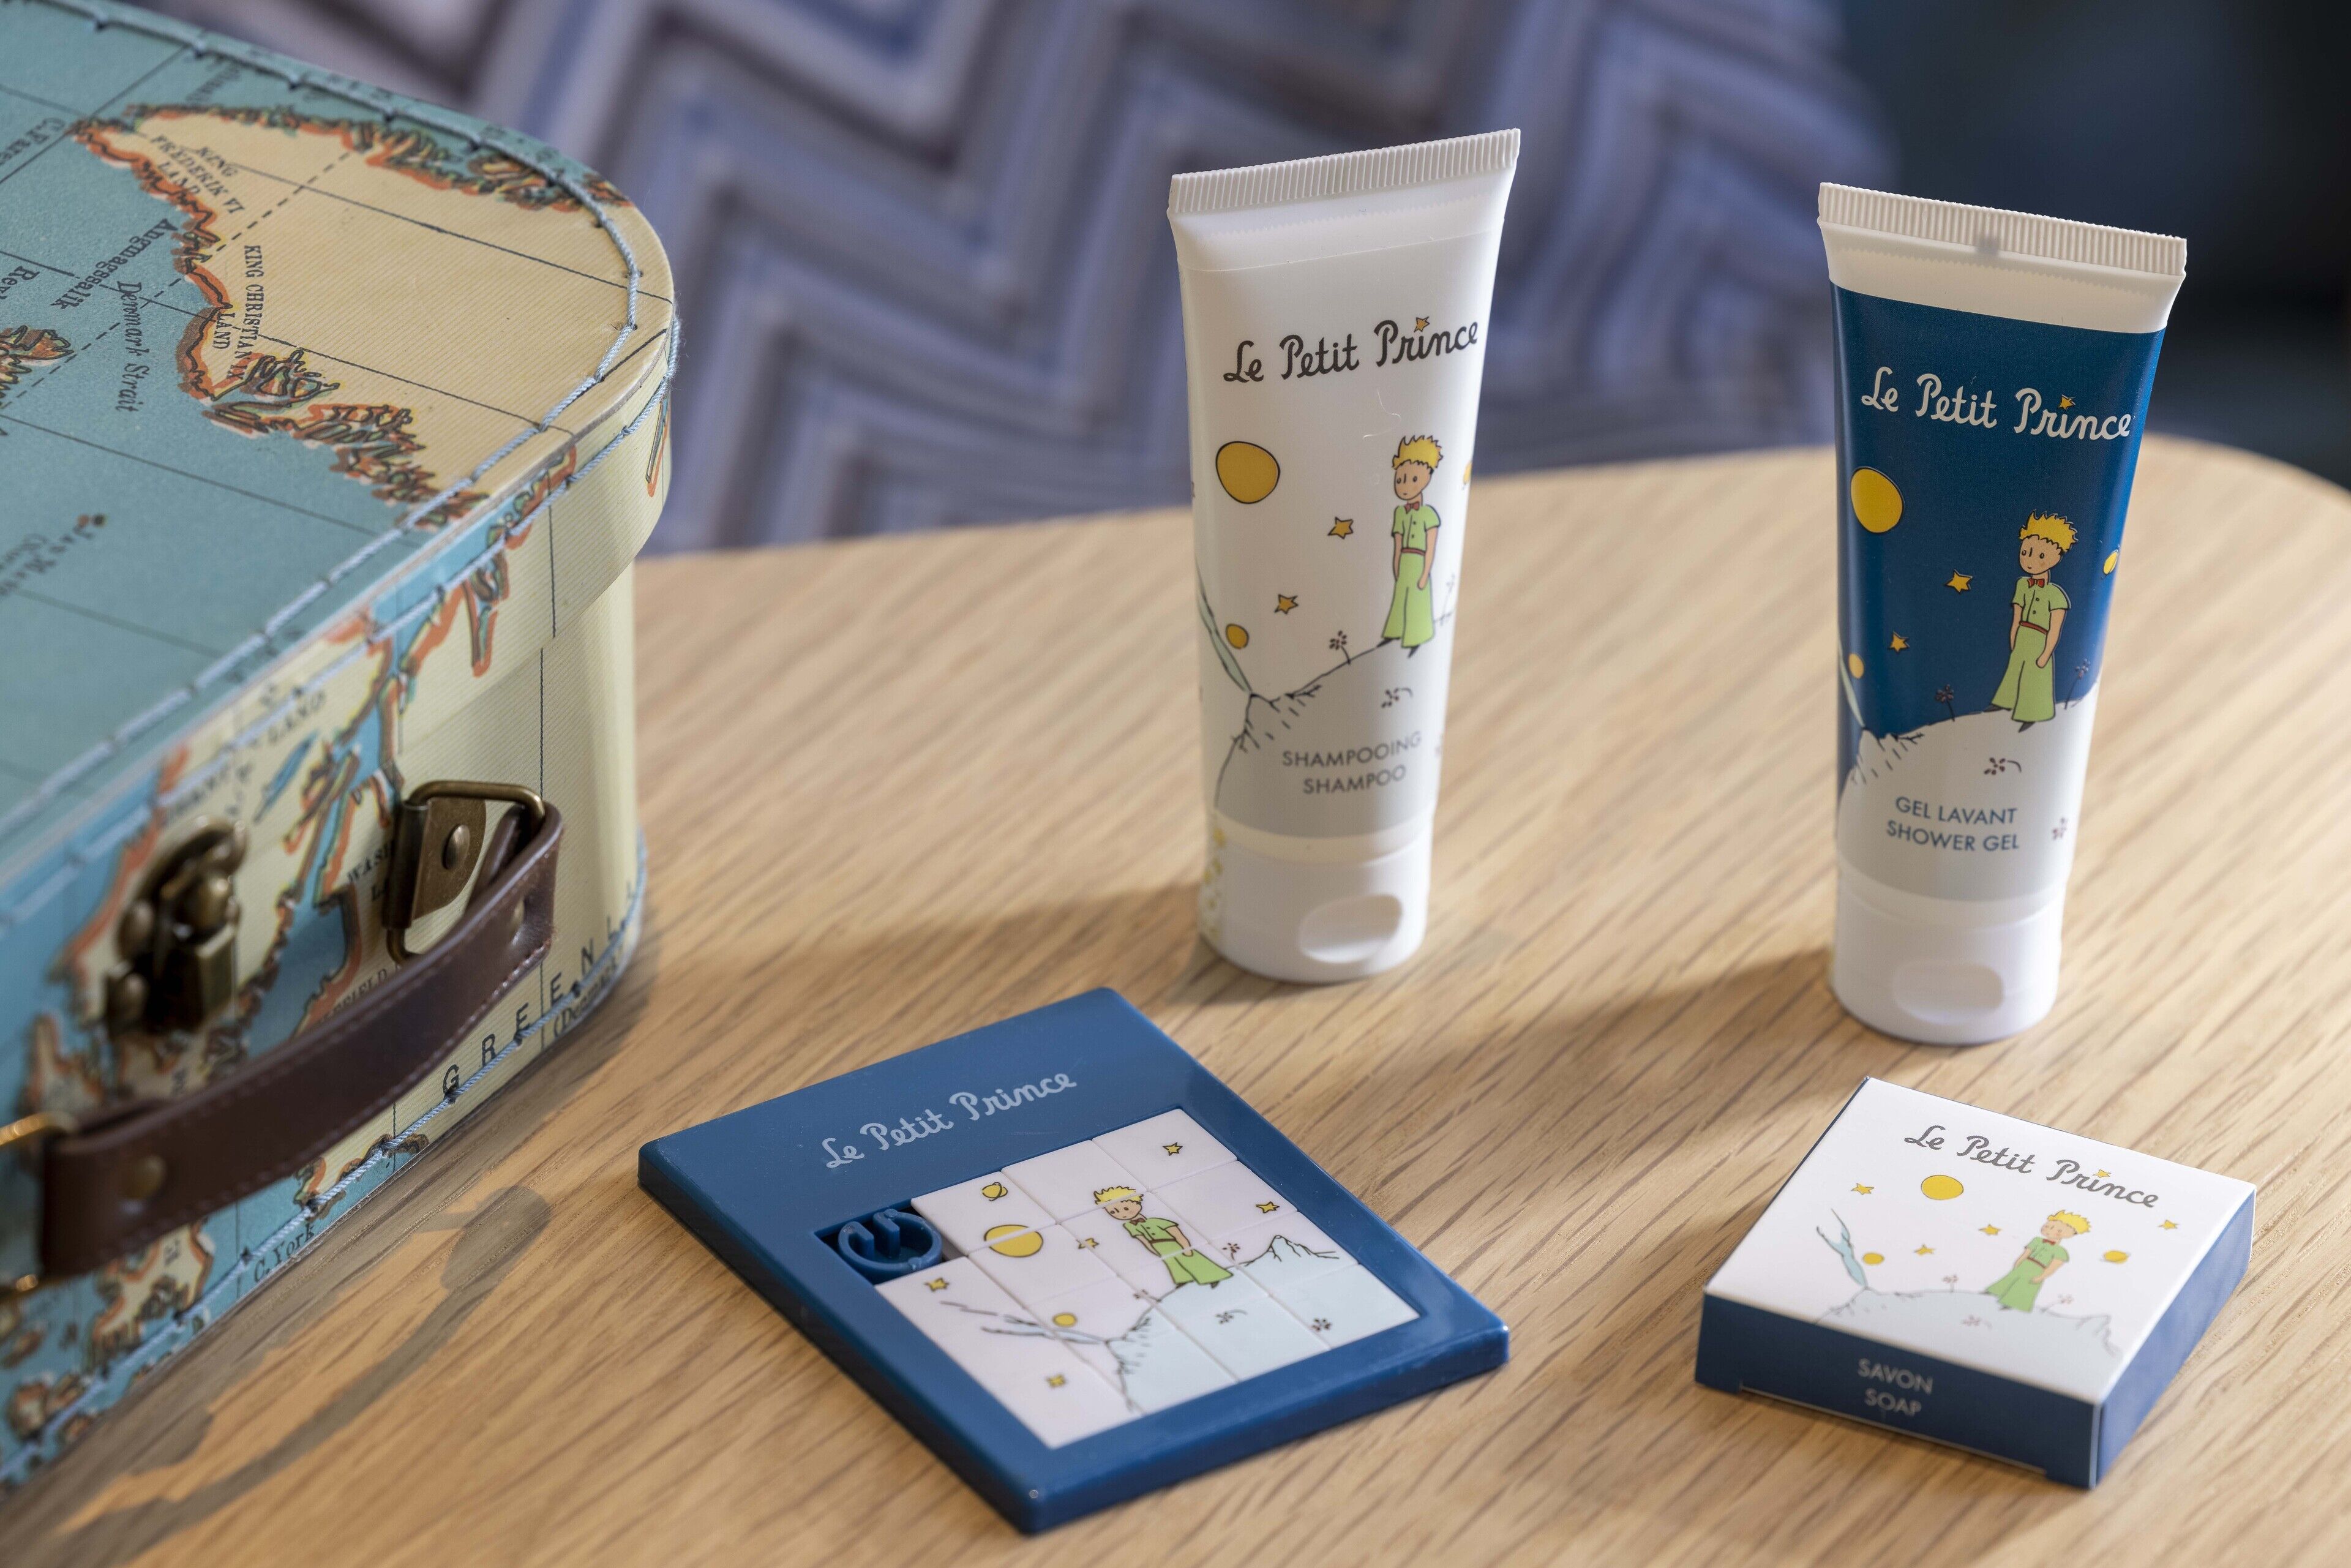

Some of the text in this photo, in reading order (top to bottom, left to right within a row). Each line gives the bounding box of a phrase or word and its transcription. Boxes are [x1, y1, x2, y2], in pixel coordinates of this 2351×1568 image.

[222, 197, 246, 214] VI
[50, 218, 179, 310] Angmagssalik
[212, 312, 236, 350] LAND
[226, 245, 264, 380] KING CHRISTIAN IX
[115, 280, 151, 412] Denmark Strait
[1223, 317, 1479, 383] Le Petit Prince
[1861, 366, 2131, 440] Le Petit Prince
[1281, 730, 1422, 767] SHAMPOOING
[1302, 765, 1406, 795] SHAMPOO
[1895, 796, 2018, 825] GEL LAVANT
[1886, 820, 2019, 852] SHOWER GEL
[822, 1073, 1078, 1169] Le Petit Prince
[1903, 1125, 2159, 1208] Le Petit Prince
[1858, 1357, 1933, 1396] SAVON
[1864, 1387, 1922, 1417] SOAP
